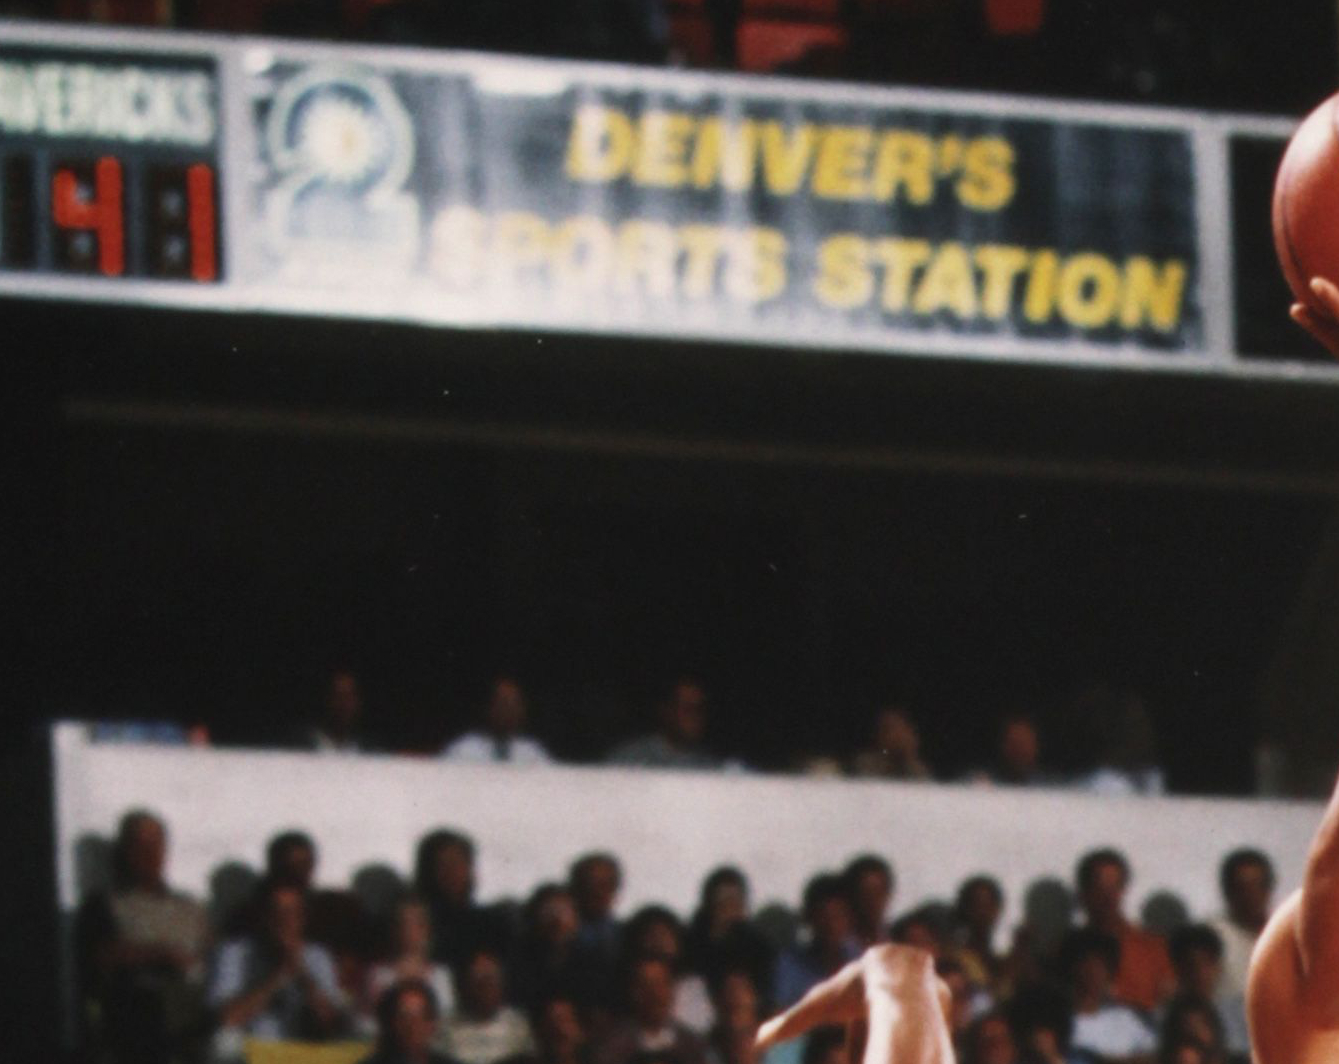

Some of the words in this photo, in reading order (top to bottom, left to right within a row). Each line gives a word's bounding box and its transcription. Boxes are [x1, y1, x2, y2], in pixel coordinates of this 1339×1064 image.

[53, 155, 217, 284] 41
[566, 104, 1016, 212] DENVER'S
[431, 206, 787, 304] SPORTS
[813, 234, 1188, 333] STATION
